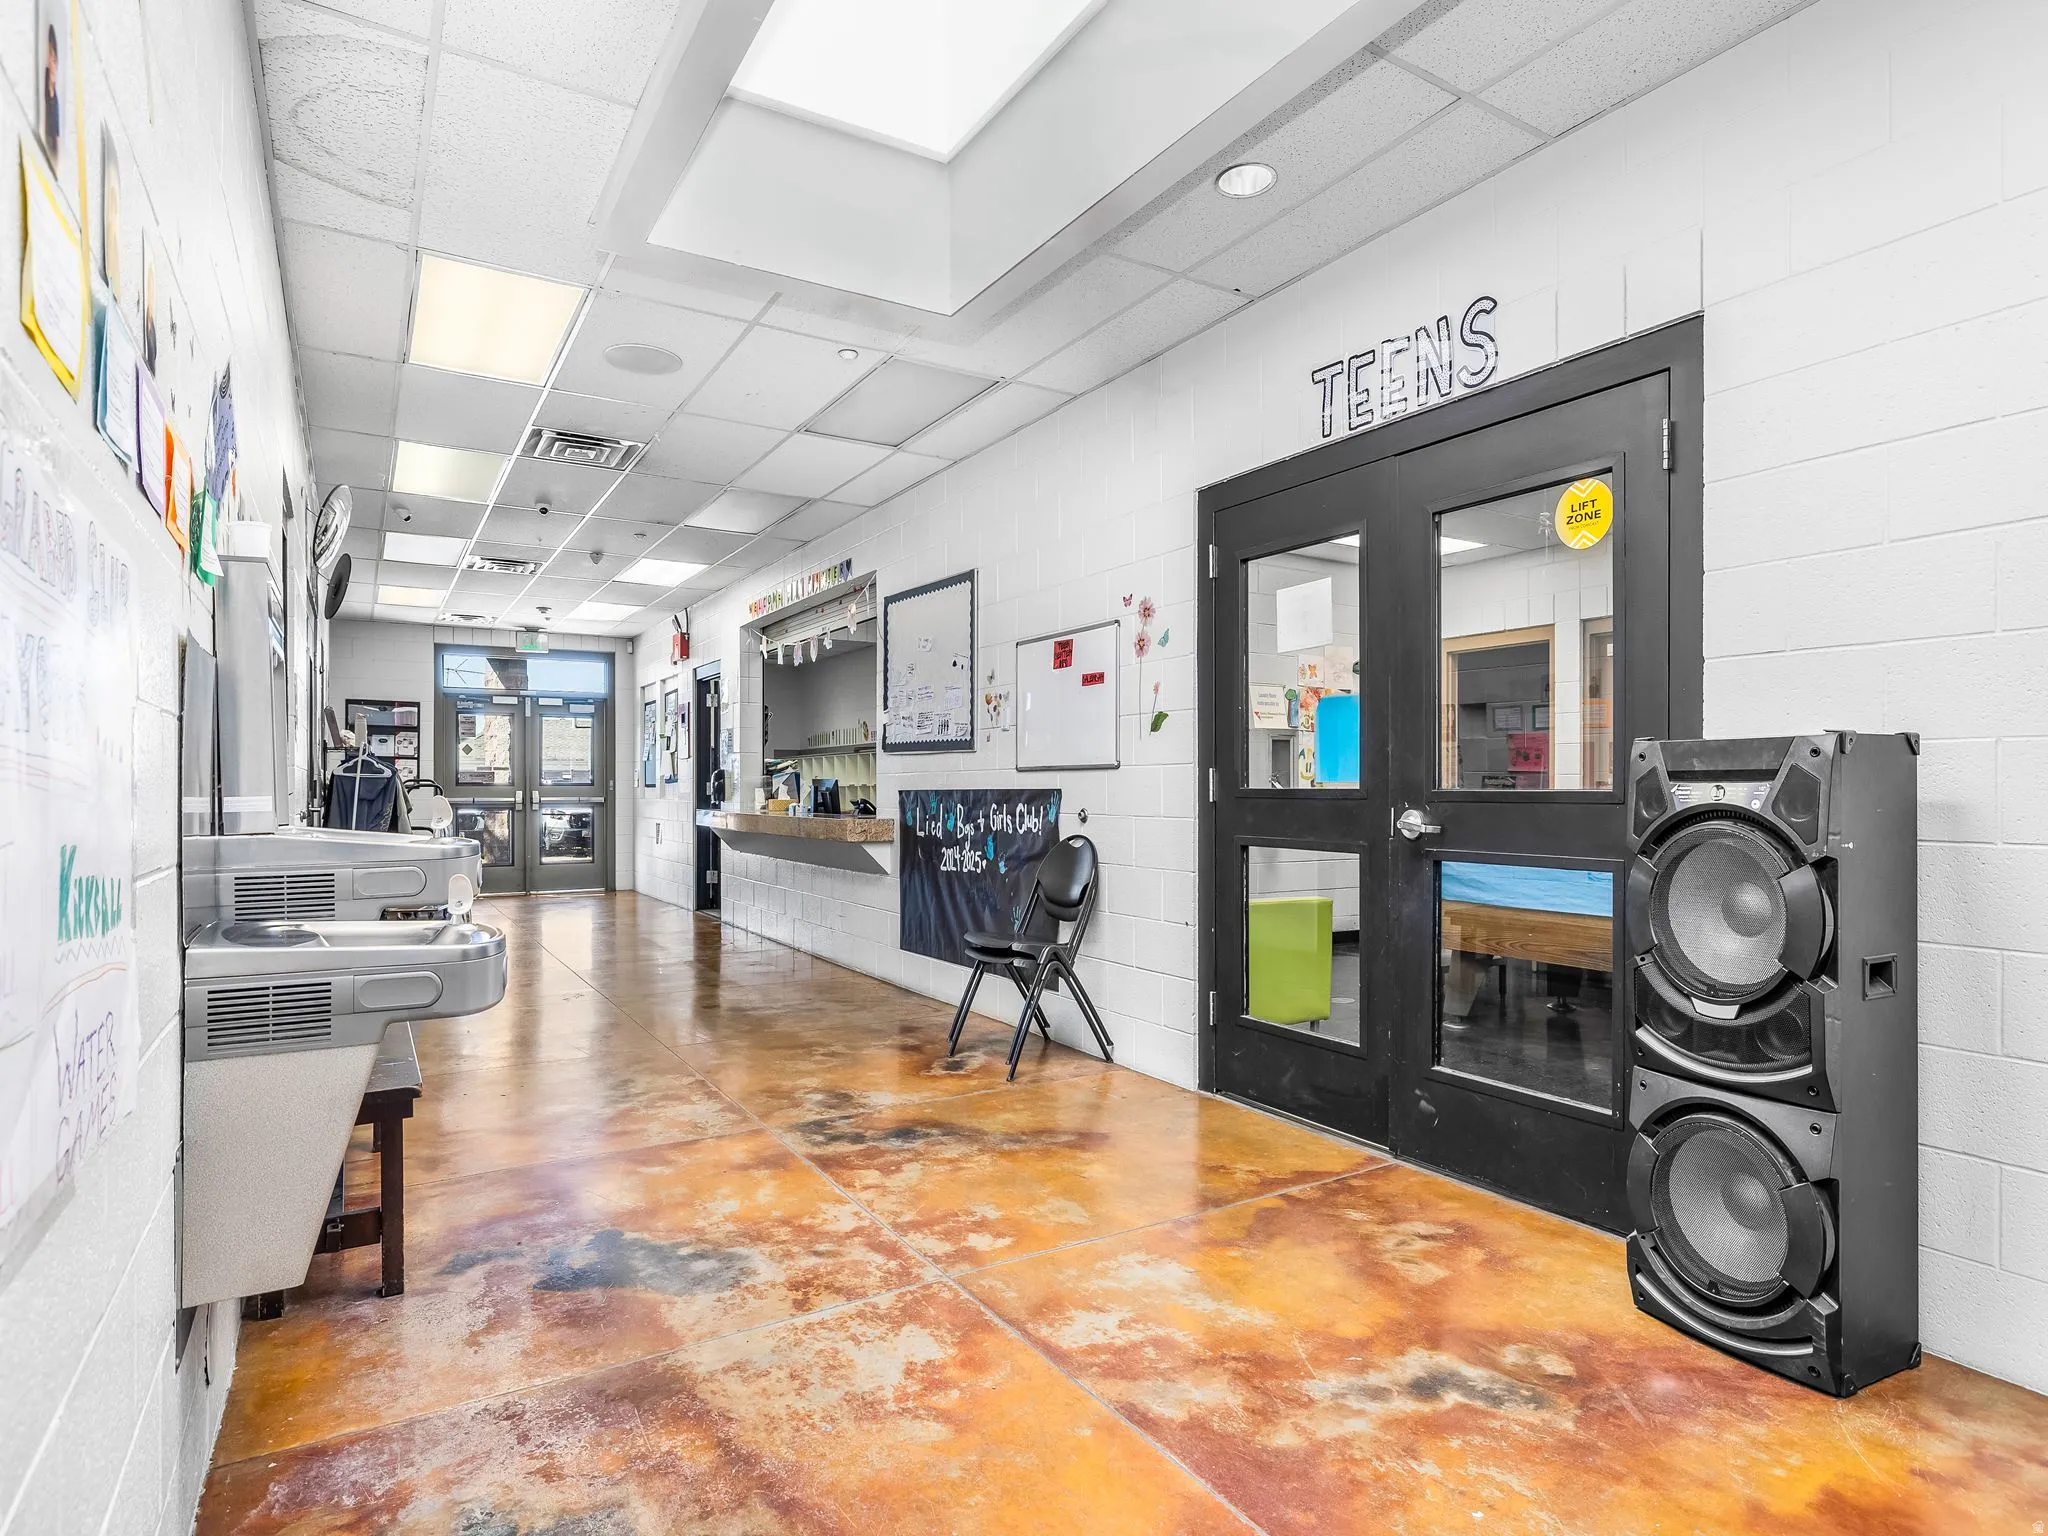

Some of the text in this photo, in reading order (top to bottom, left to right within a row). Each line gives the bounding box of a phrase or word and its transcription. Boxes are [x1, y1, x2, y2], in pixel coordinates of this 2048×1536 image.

[1312, 296, 1498, 438] TEENS
[1566, 510, 1601, 525] ZONE
[1571, 499, 1597, 513] LIFT
[917, 803, 943, 840] Lied
[989, 803, 1012, 835] Girls
[1015, 803, 1043, 836] Club!
[940, 845, 983, 874] 2024-2025
[54, 1008, 115, 1108] WATER
[55, 1070, 116, 1184] GAMES
